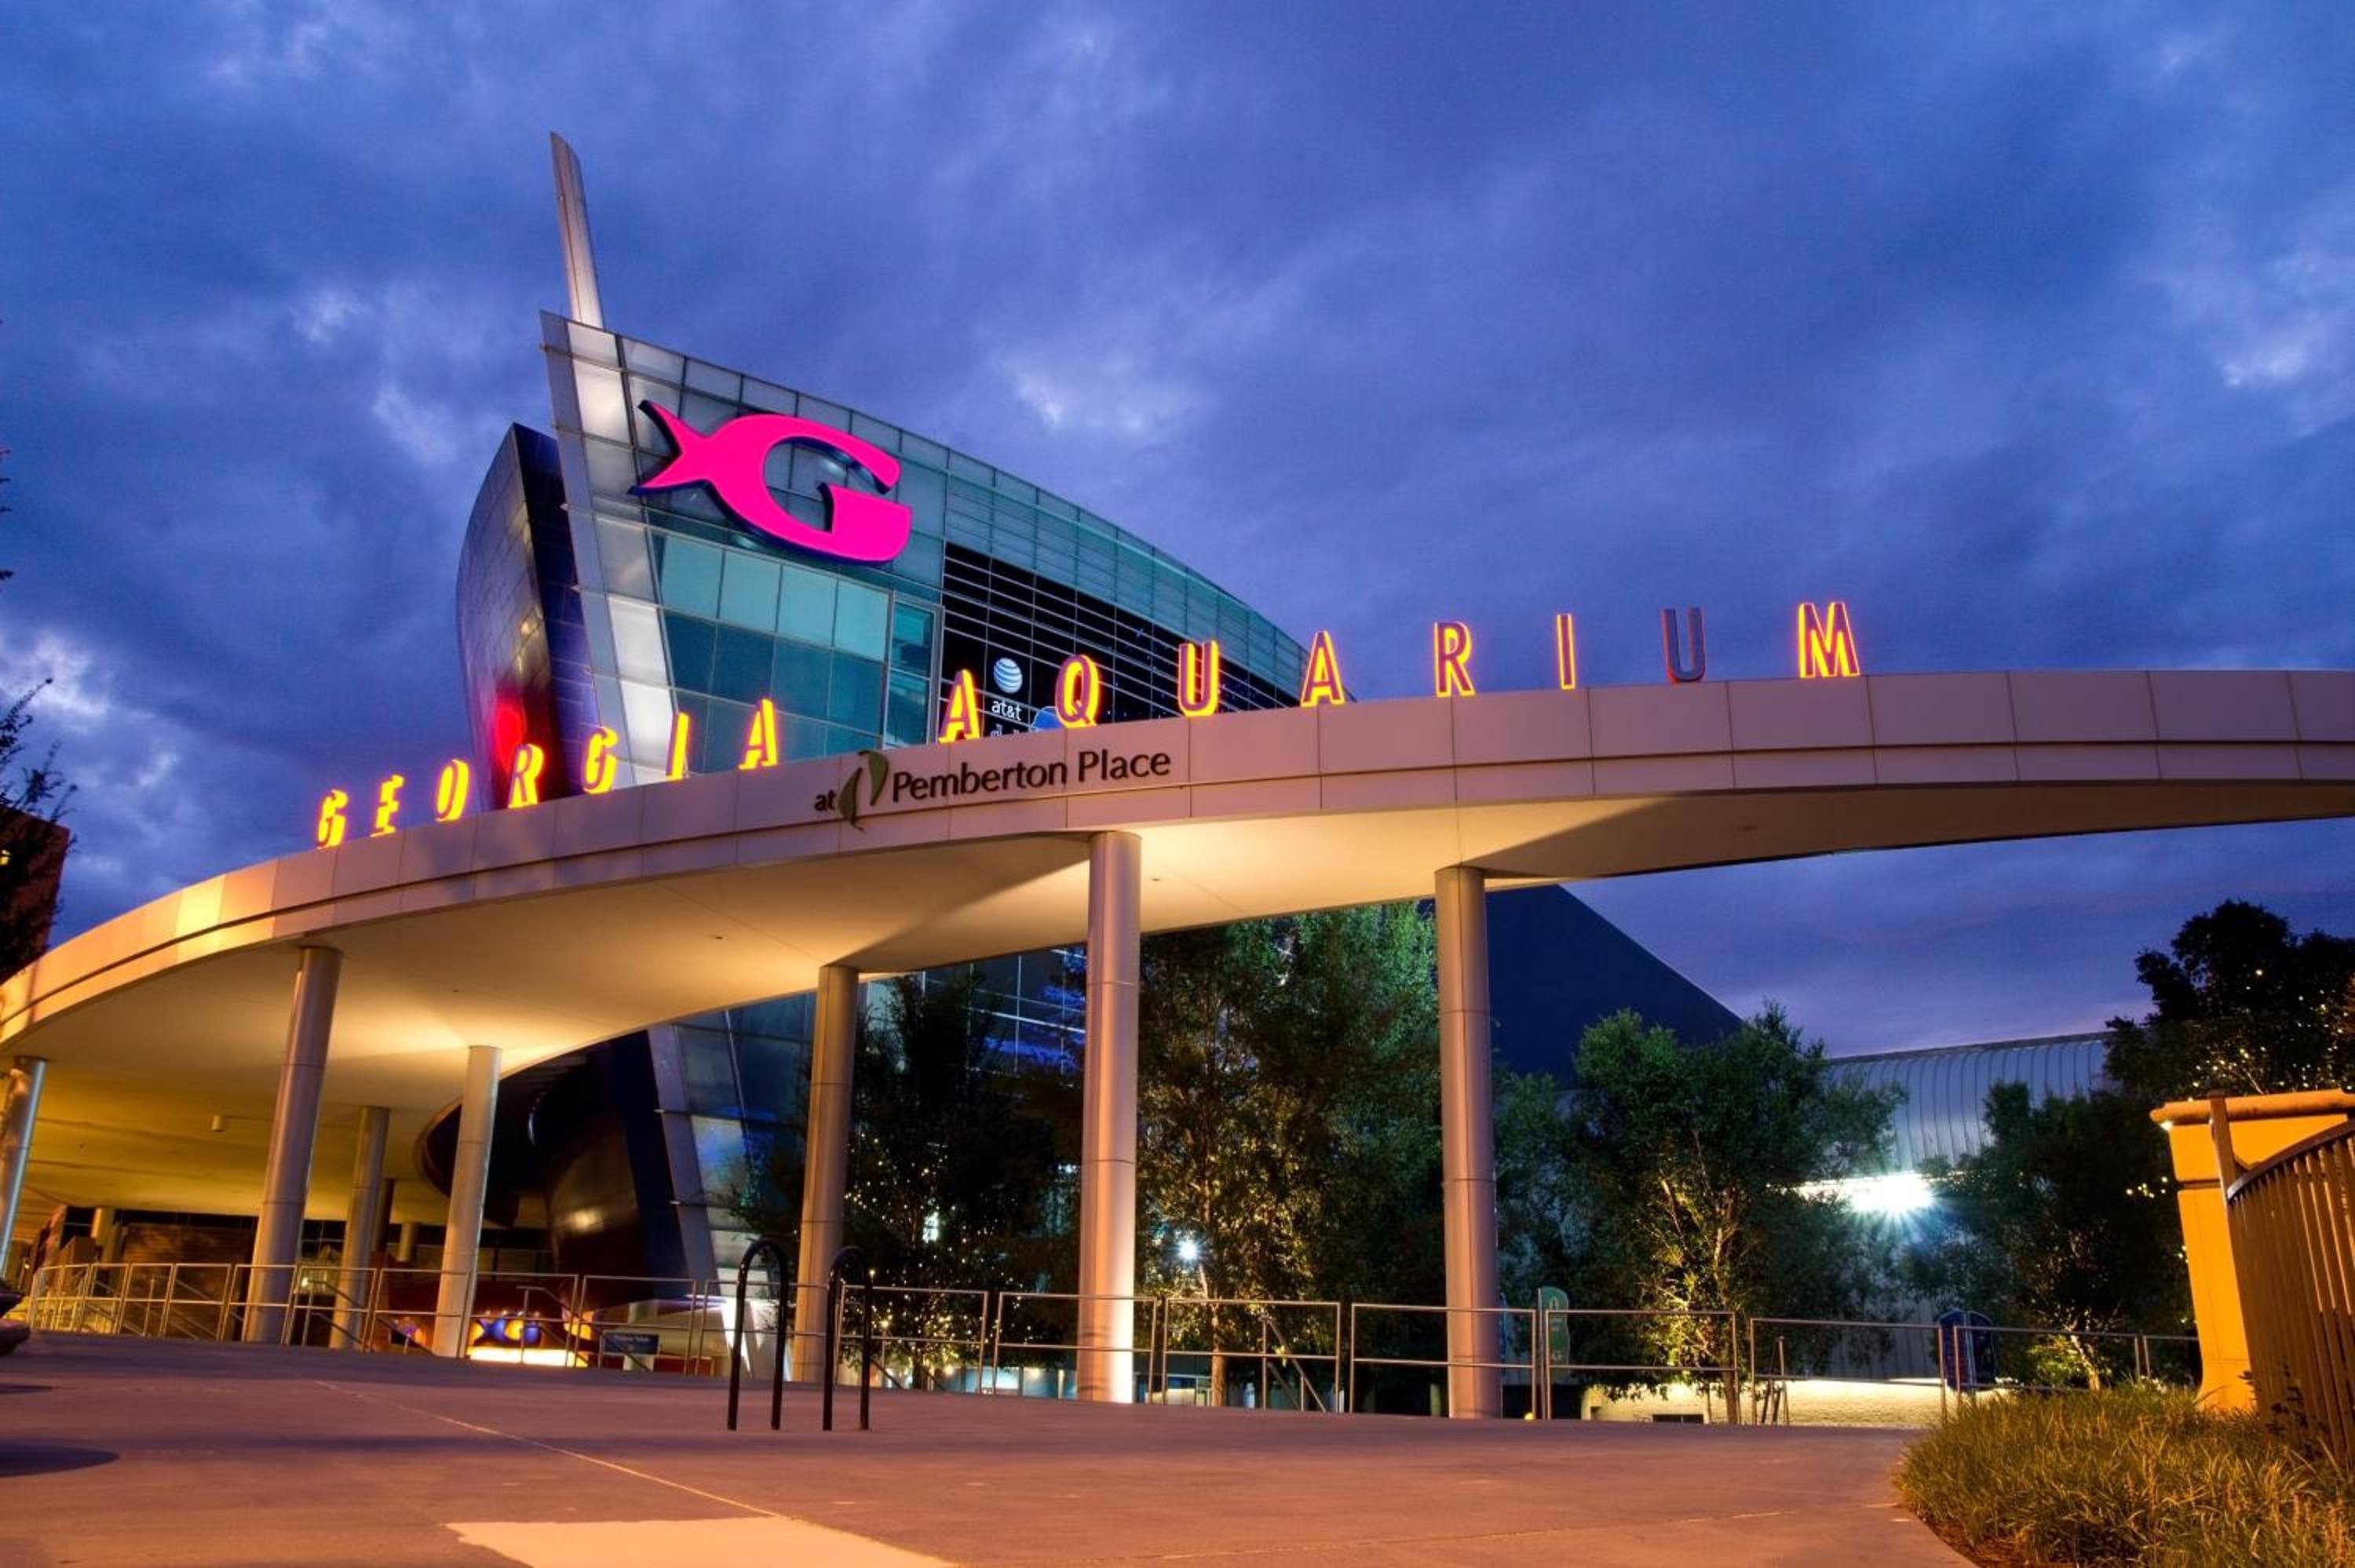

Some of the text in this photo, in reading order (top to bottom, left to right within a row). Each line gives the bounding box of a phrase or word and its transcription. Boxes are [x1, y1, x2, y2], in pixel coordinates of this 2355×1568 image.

[316, 601, 1861, 849] GEORGIA AQUARIUM
[814, 748, 1171, 811] at Pemberton Place
